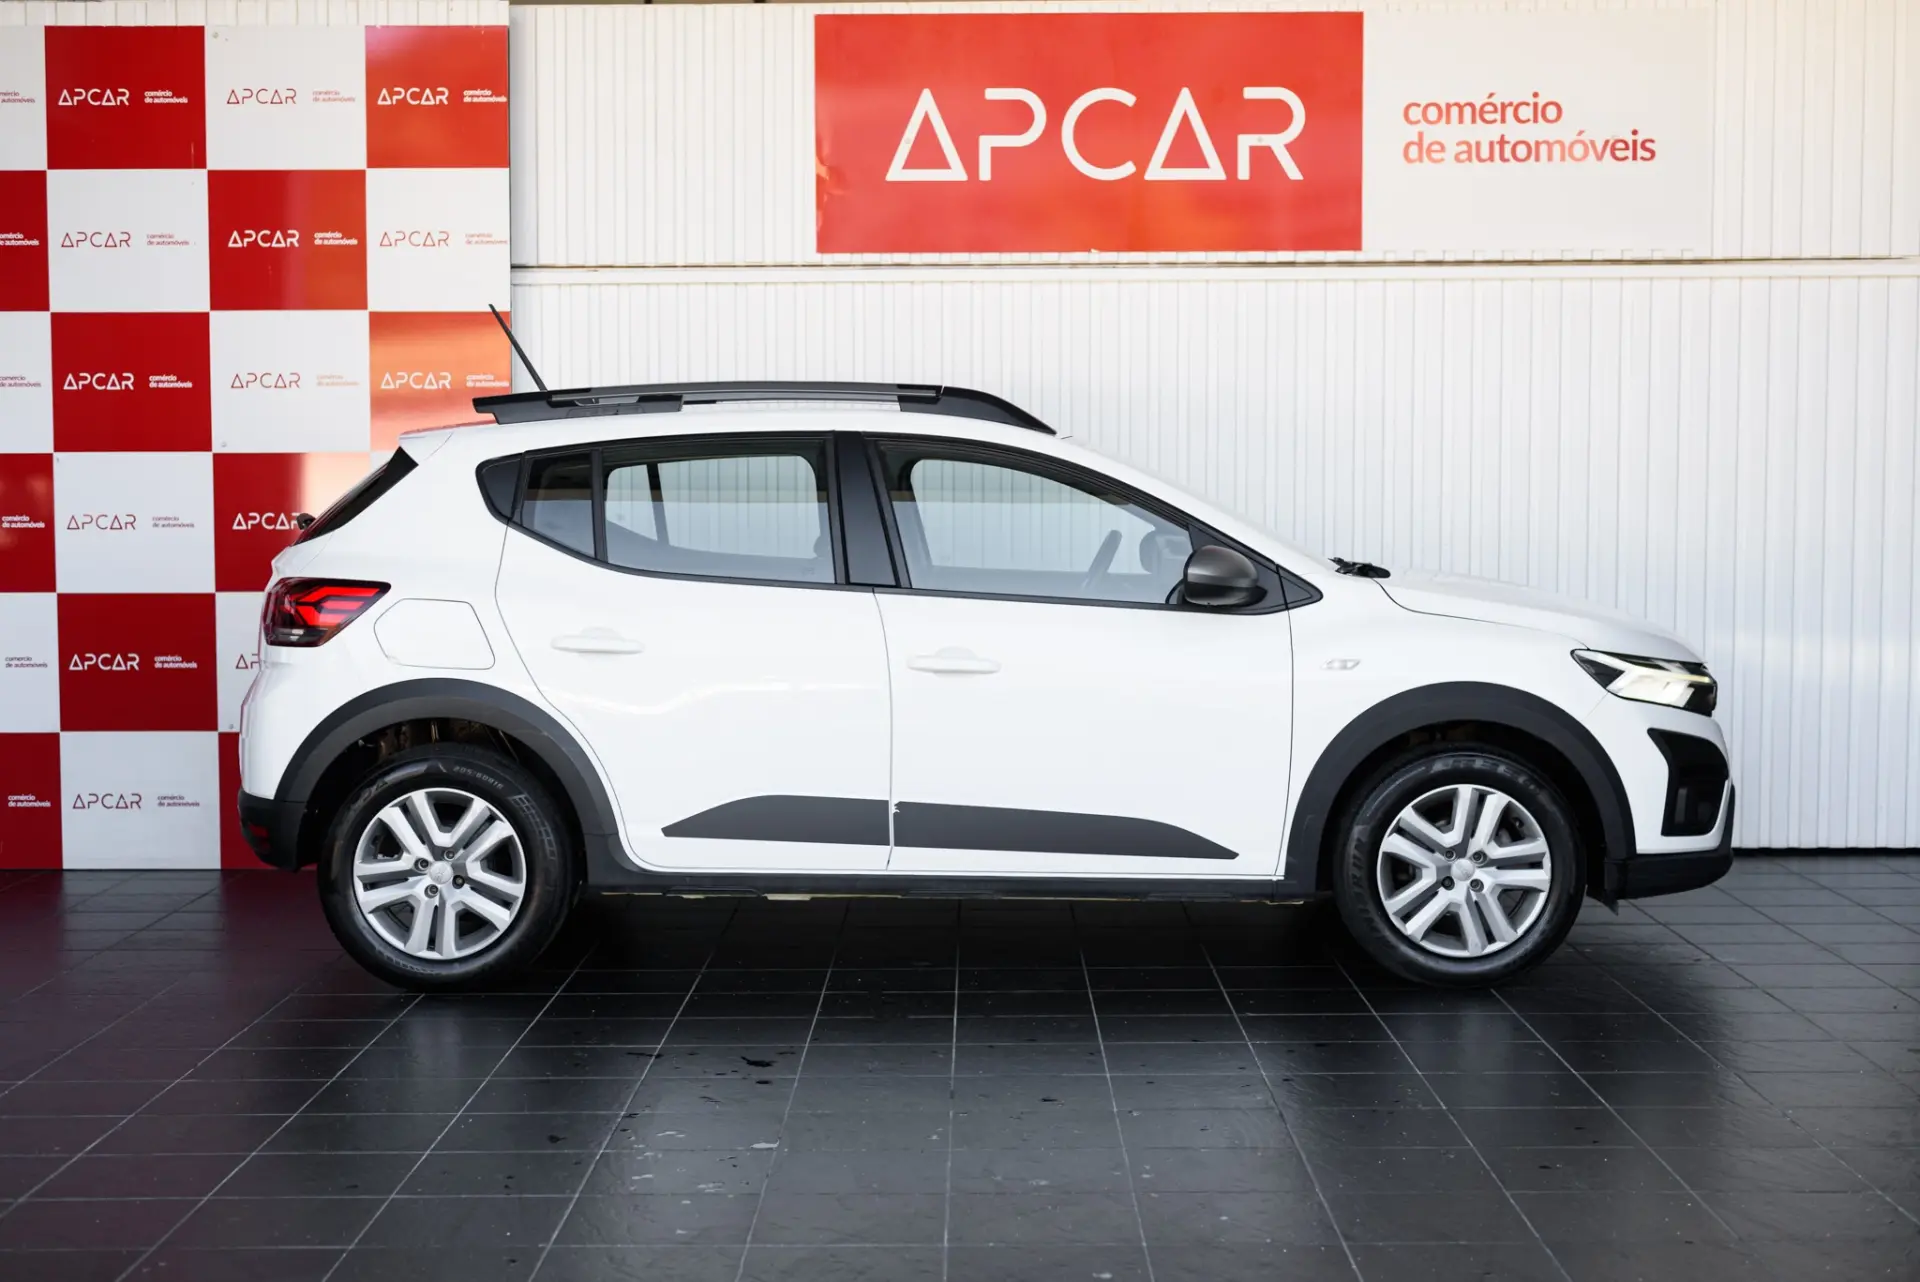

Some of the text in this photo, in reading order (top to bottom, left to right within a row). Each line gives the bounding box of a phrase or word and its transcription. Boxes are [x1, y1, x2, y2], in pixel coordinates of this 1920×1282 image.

[58, 88, 130, 106] APCAR
[227, 88, 297, 105] APCAR
[377, 87, 449, 106] APCAR
[1403, 91, 1564, 125] comércio
[885, 87, 1306, 181] APCAR
[1403, 129, 1657, 164] de automóveis
[61, 231, 131, 248] APCAR
[228, 230, 299, 248] APCAR
[380, 231, 449, 247] APCAR
[63, 372, 135, 391] APCAR
[231, 373, 301, 389] APCAR
[380, 371, 452, 390] APCAR
[67, 514, 137, 530] APCAR
[69, 653, 140, 671] APCAR
[73, 793, 142, 810] APCAR
